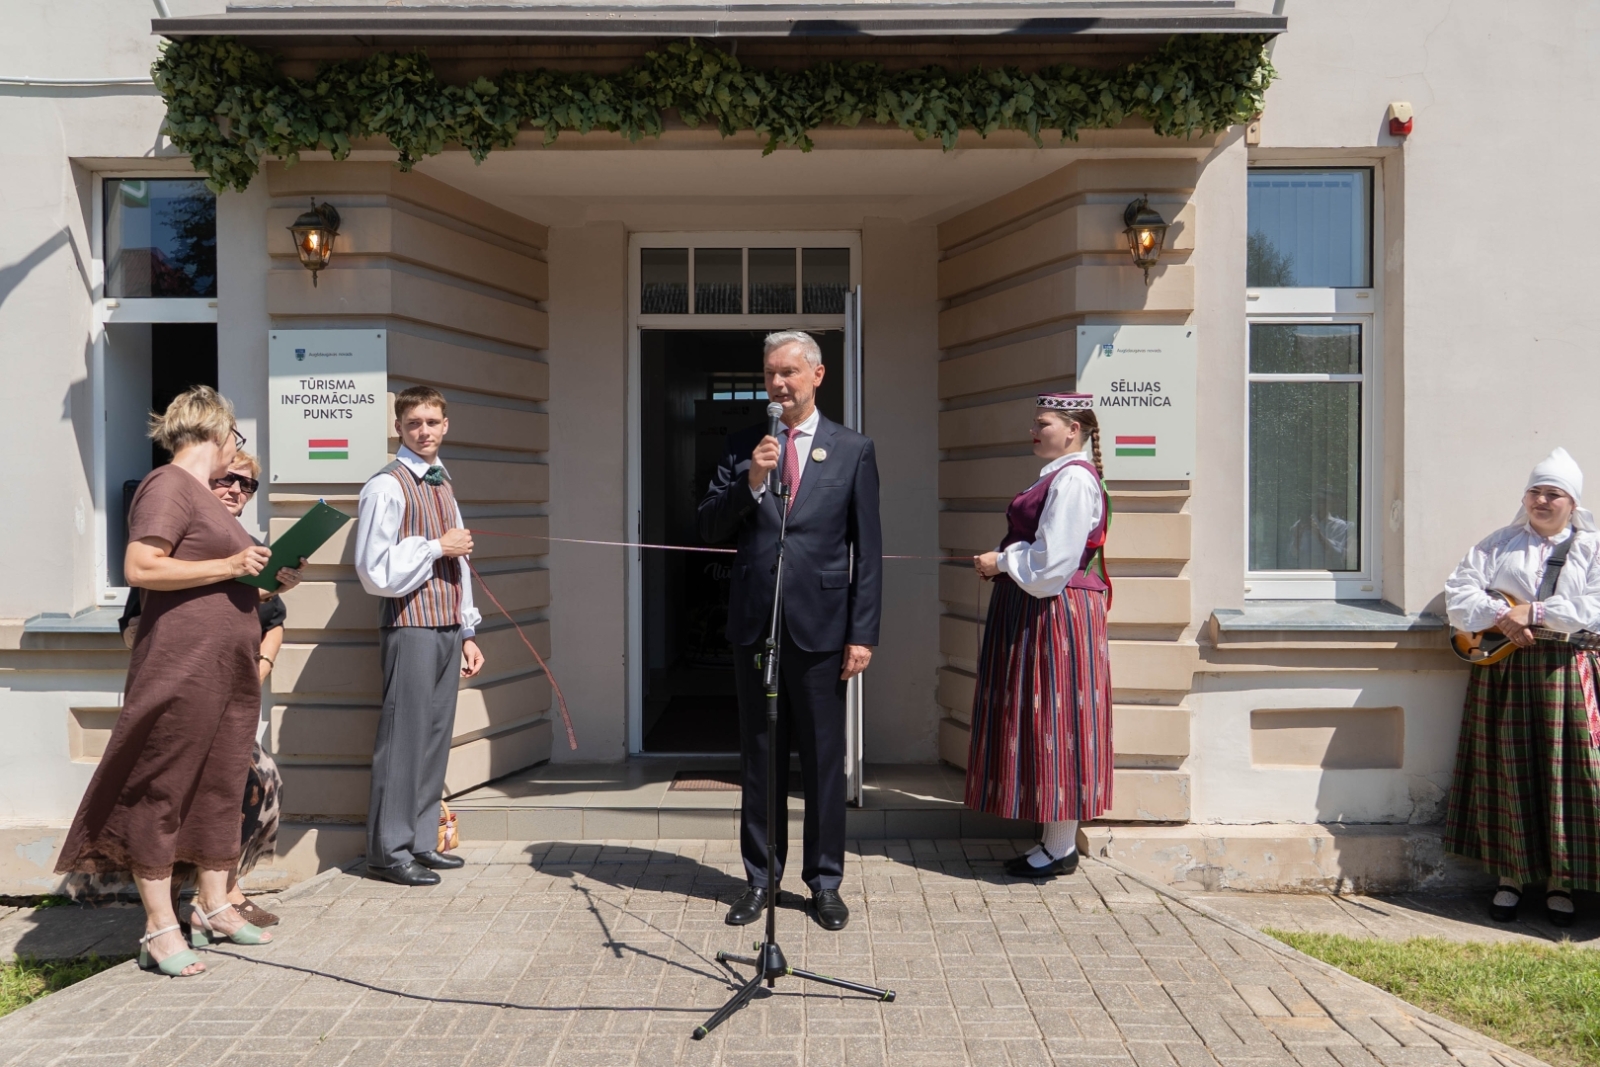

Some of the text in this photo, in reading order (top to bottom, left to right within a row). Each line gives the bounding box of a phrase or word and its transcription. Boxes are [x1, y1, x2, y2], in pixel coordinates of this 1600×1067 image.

[299, 377, 356, 390] TŪRISMA
[1110, 379, 1161, 393] SĒLIJAS
[281, 392, 375, 404] INFORMĀCIJAS
[1099, 394, 1172, 407] MANTNĪCA
[303, 409, 353, 419] PUNKTS
[703, 562, 732, 581] Ilū
